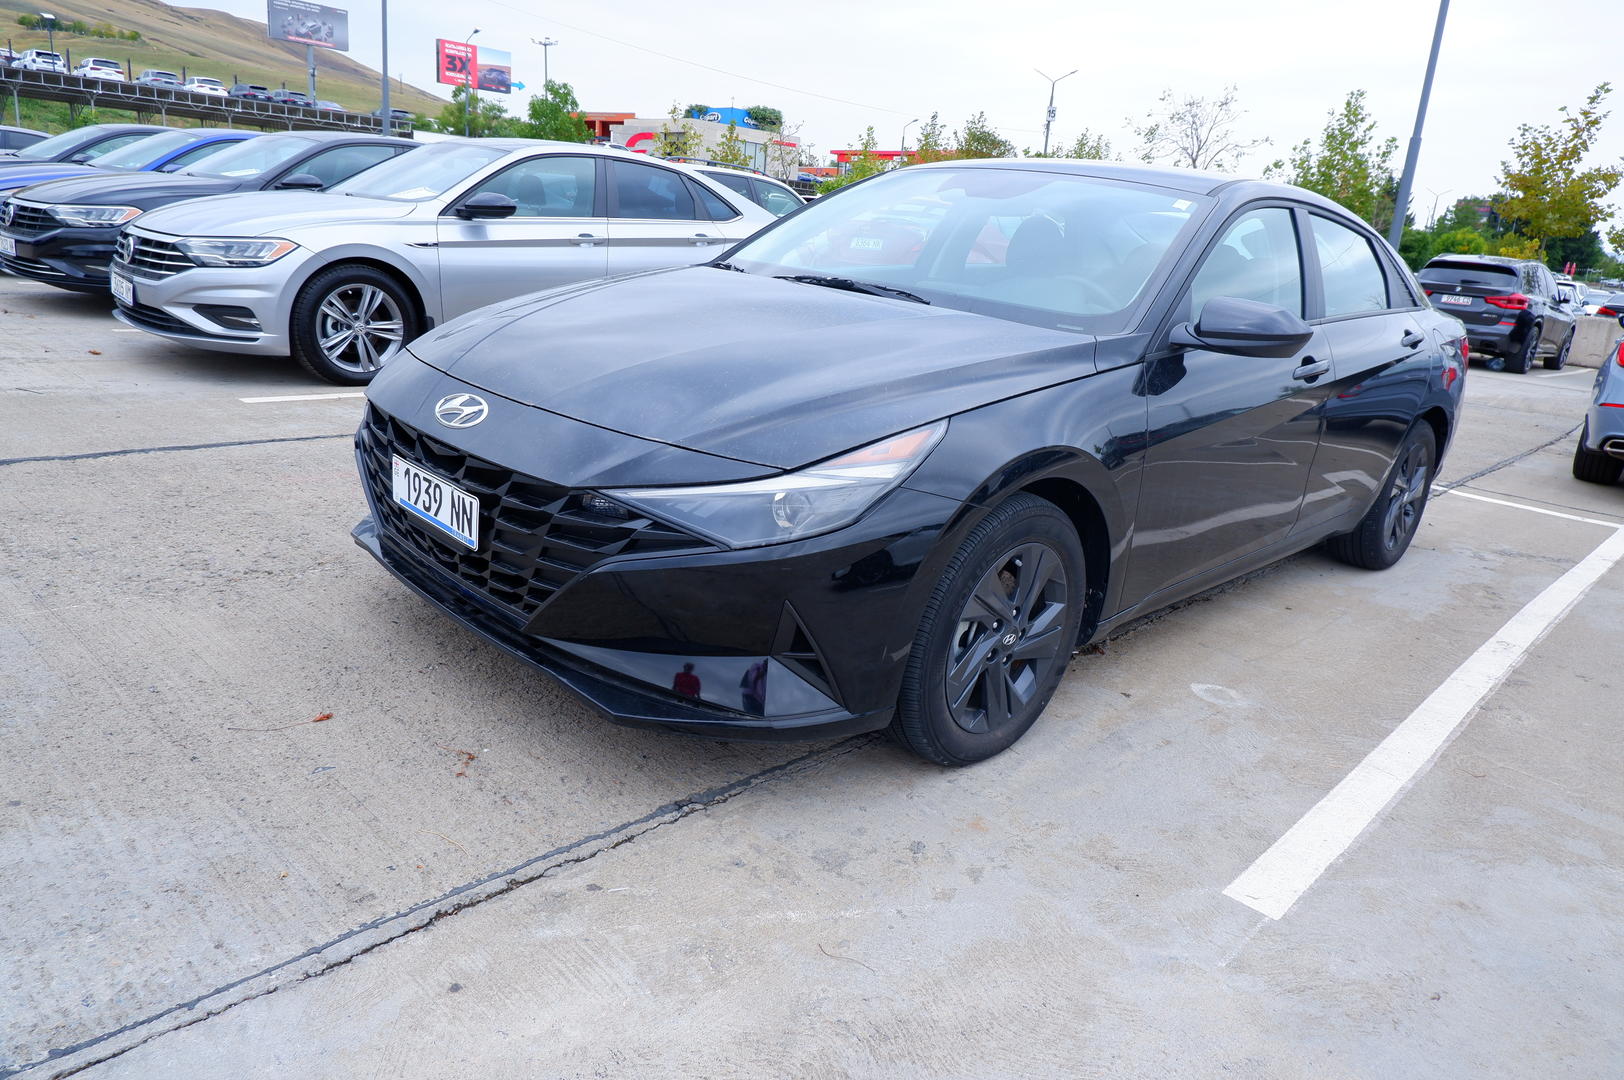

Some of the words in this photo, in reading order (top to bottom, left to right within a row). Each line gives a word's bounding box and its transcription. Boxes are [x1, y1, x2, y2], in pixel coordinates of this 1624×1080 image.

[445, 54, 471, 75] 3X
[1048, 109, 1056, 118] 15
[404, 467, 443, 517] 1939
[450, 490, 473, 538] NN
